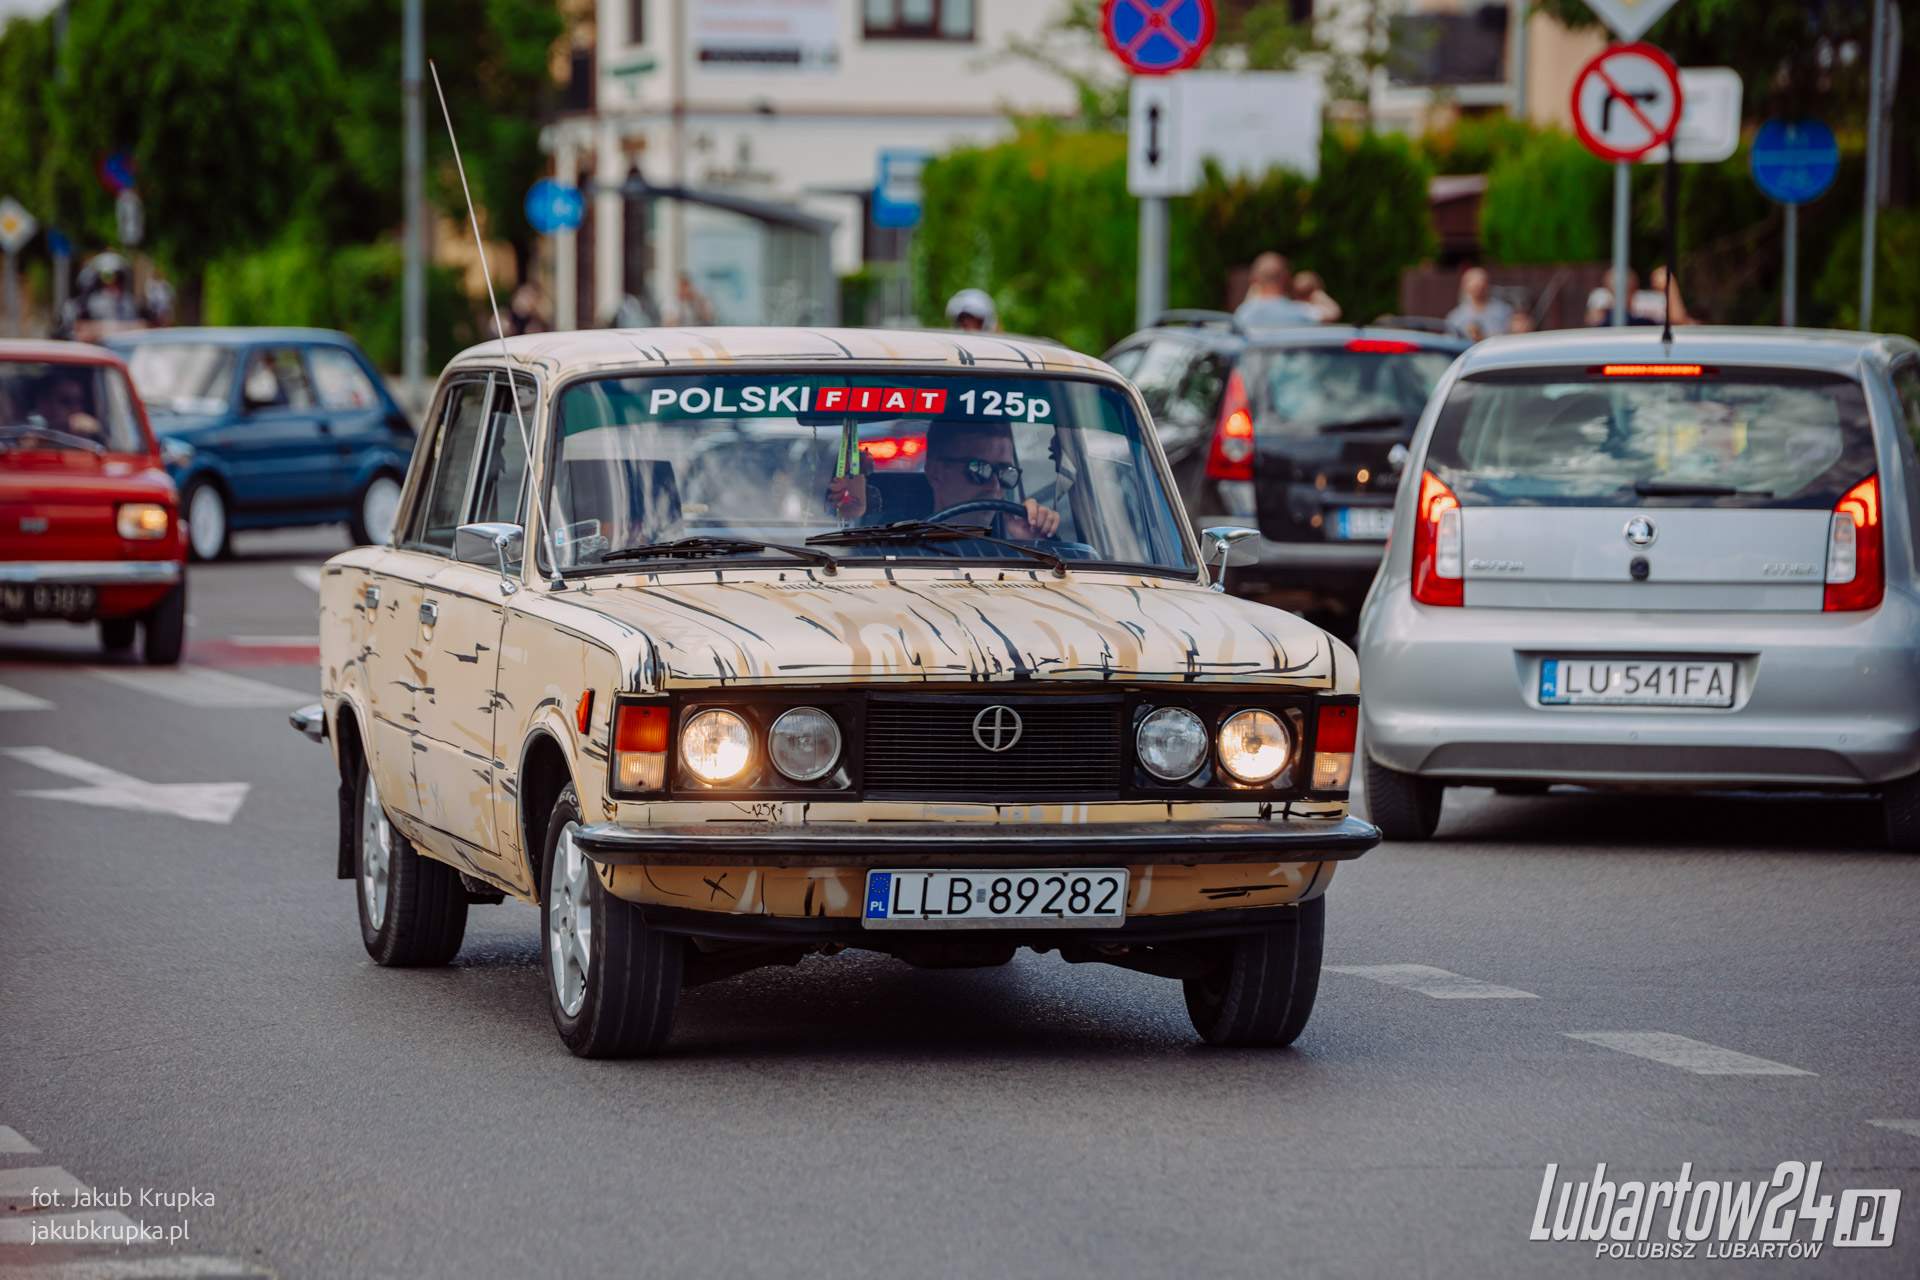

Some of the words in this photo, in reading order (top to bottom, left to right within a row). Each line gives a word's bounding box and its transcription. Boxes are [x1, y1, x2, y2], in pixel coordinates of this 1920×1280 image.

[649, 386, 811, 415] POLSKI
[824, 389, 940, 411] FIAT
[958, 389, 1052, 423] 125p
[1565, 664, 1611, 694] LU
[1623, 665, 1724, 696] 541FA
[869, 901, 885, 912] PL
[892, 877, 973, 915] LLB
[988, 876, 1119, 915] 89282
